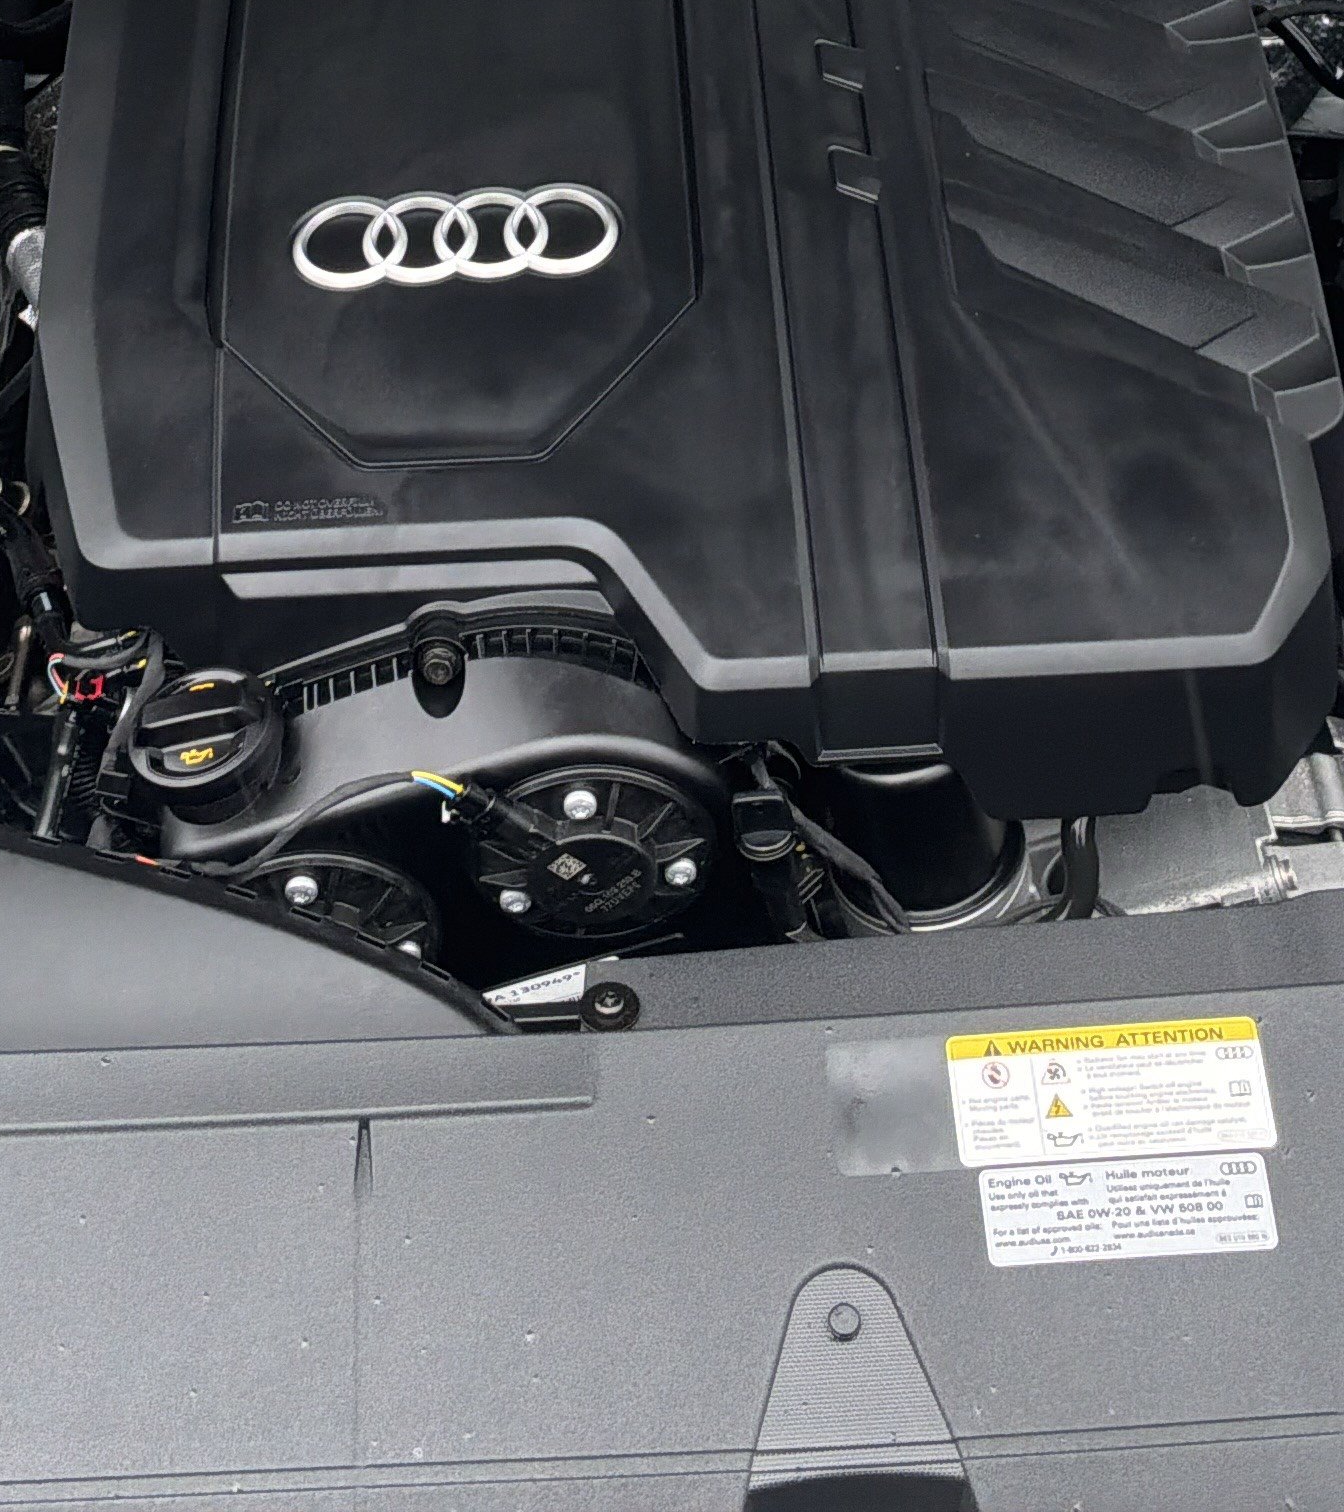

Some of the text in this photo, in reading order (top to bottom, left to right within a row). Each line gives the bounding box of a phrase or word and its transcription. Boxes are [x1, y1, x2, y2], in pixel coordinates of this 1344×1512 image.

[1007, 1026, 1224, 1054] WARNING ATTENTION
[987, 1174, 1052, 1189] Engine Oil
[1105, 1167, 1190, 1180] Huile moteur
[1056, 1209, 1084, 1221] SAE
[1135, 1205, 1146, 1216] &
[1150, 1204, 1175, 1214] VW
[1207, 1200, 1224, 1211] 00
